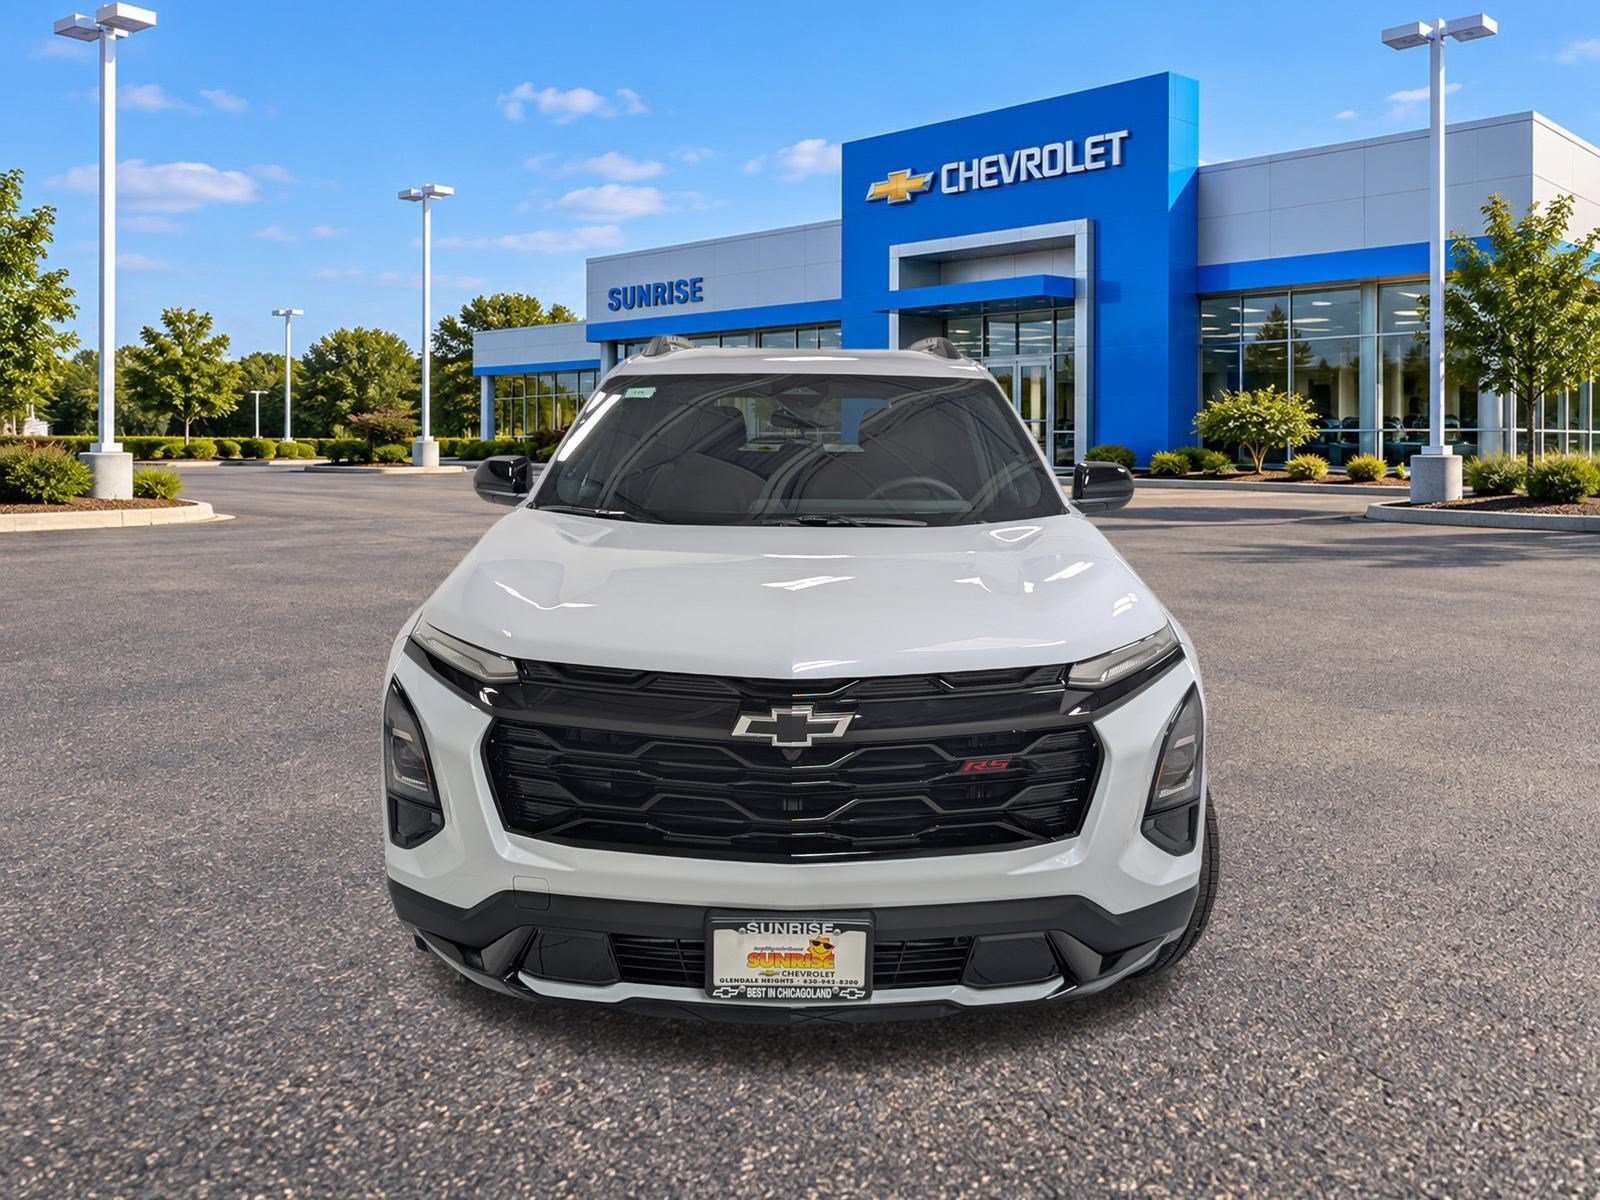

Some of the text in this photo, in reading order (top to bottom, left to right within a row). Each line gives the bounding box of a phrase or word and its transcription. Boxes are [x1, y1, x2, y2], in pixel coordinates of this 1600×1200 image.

[941, 130, 1129, 194] CHEVROLET
[608, 277, 704, 312] SUNRISE
[963, 759, 1009, 773] RS
[746, 922, 834, 935] SUNRISE
[747, 952, 835, 969] SUNRISE
[781, 970, 836, 978] CHEVROLET
[746, 987, 832, 999] BEST IN CHICAGOLAND
